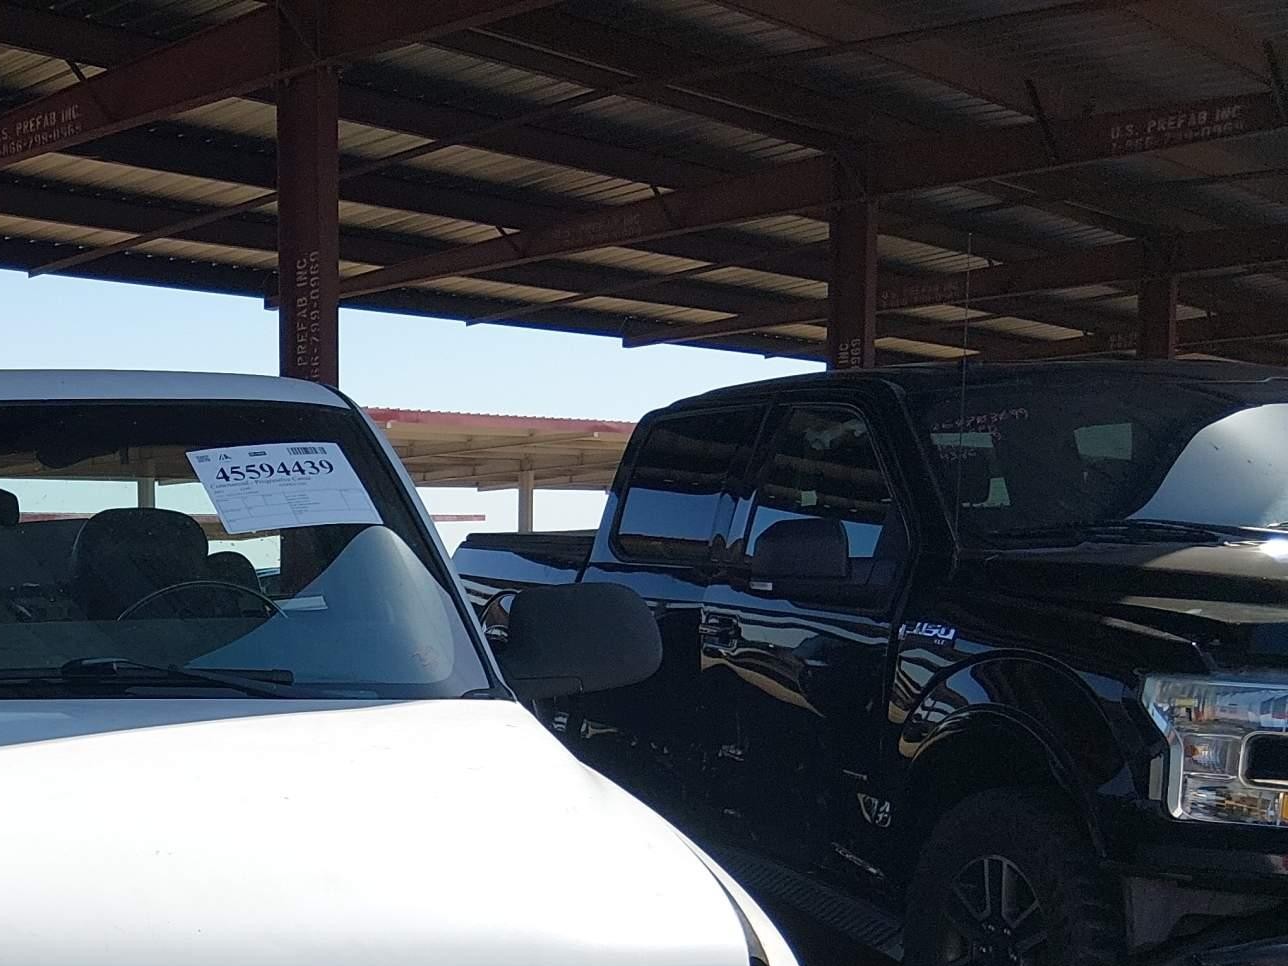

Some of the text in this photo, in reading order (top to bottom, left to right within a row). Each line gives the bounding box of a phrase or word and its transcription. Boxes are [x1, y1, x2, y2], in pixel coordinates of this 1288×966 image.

[15, 111, 57, 137] PREFAB
[1146, 110, 1208, 134] PREFAB
[296, 295, 309, 367] PREFAB
[215, 458, 334, 482] 45594439
